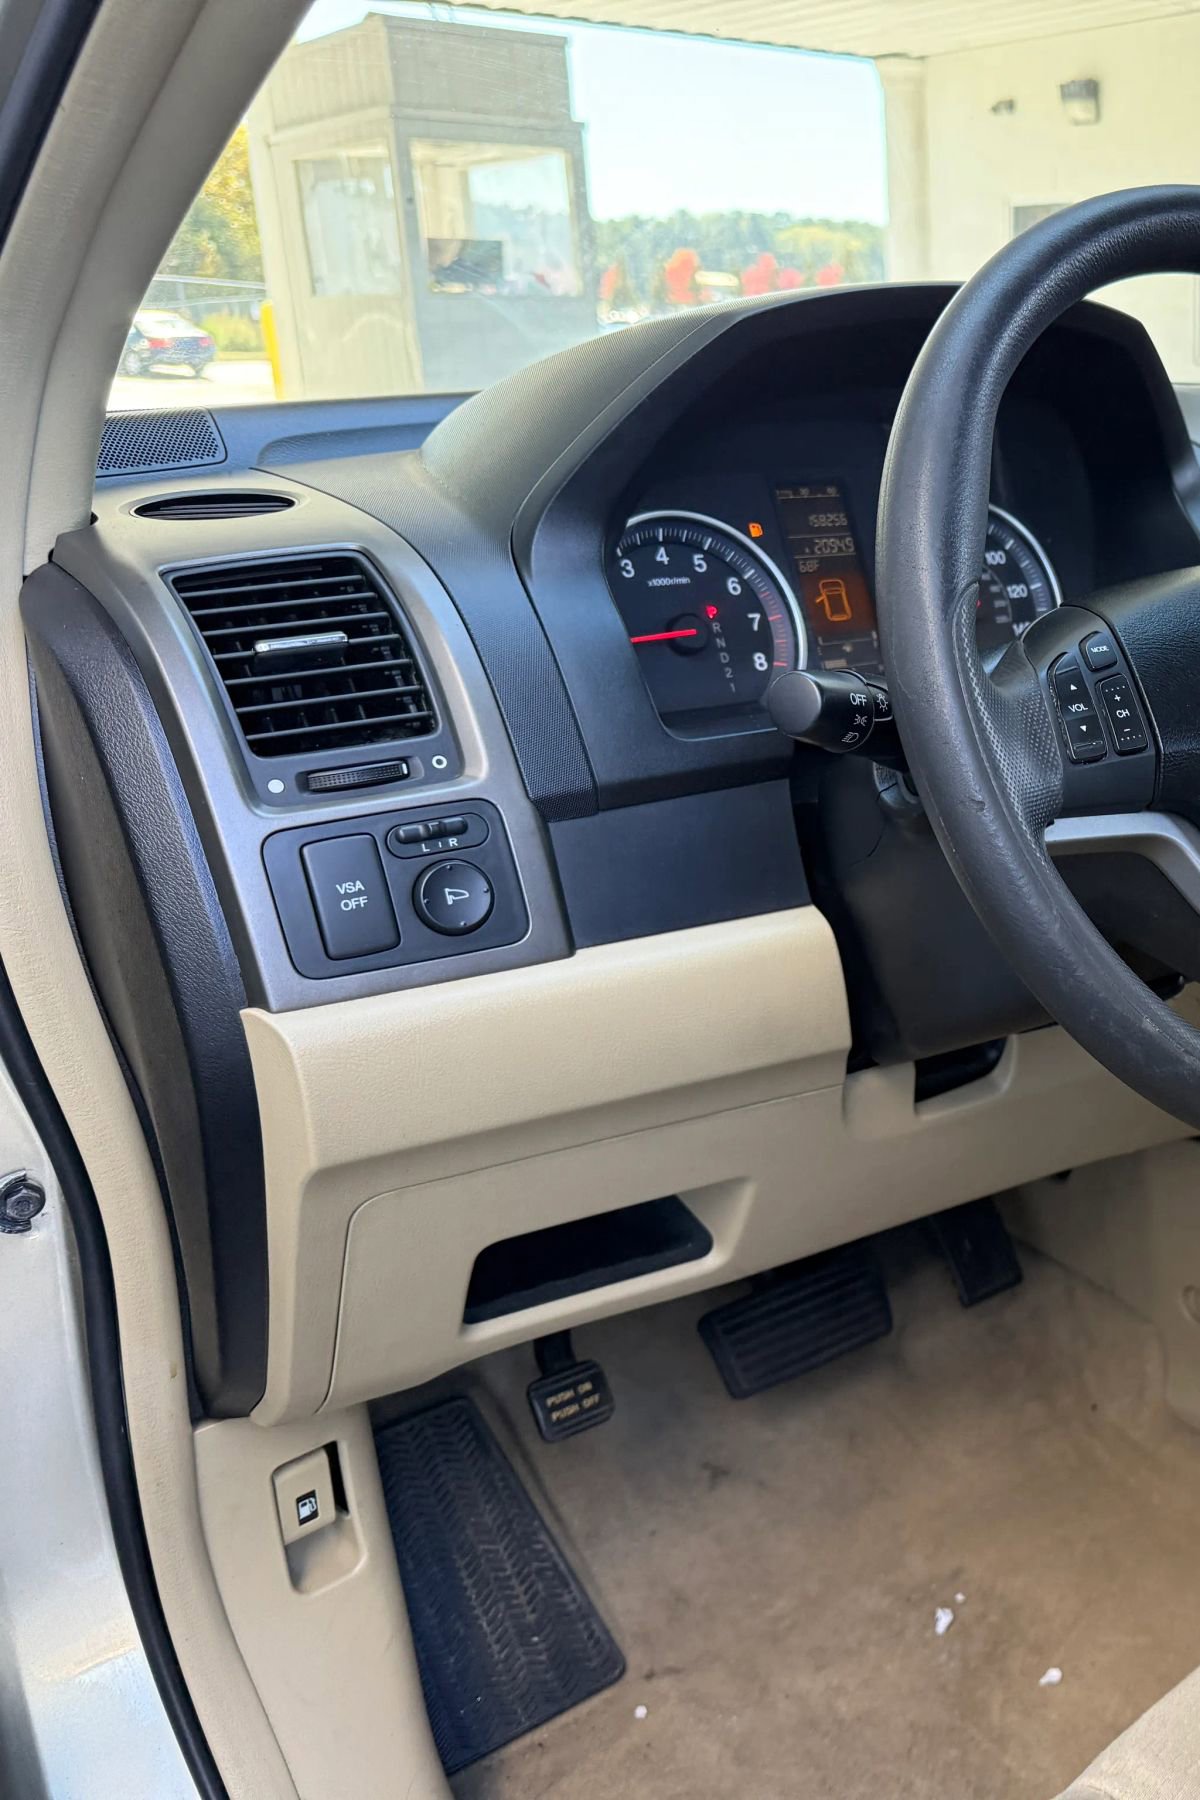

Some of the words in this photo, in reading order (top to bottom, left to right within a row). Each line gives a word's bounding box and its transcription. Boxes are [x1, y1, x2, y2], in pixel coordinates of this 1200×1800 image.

[655, 546, 670, 565] 4
[985, 550, 1006, 565] 100
[620, 558, 635, 578] 3
[692, 553, 708, 573] 5
[726, 576, 742, 596] 6
[1006, 584, 1028, 598] 120
[712, 622, 722, 634] R
[746, 613, 761, 632] 7
[715, 637, 727, 649] N
[1090, 645, 1110, 653] MODE
[719, 651, 730, 664] D
[752, 652, 768, 671] 8
[724, 667, 734, 679] 2
[849, 692, 868, 706] OFF
[1068, 702, 1089, 713] VOL
[1116, 708, 1131, 718] CH
[421, 843, 431, 852] L
[448, 837, 459, 847] R
[336, 880, 365, 894] VSA
[341, 896, 368, 910] OFF
